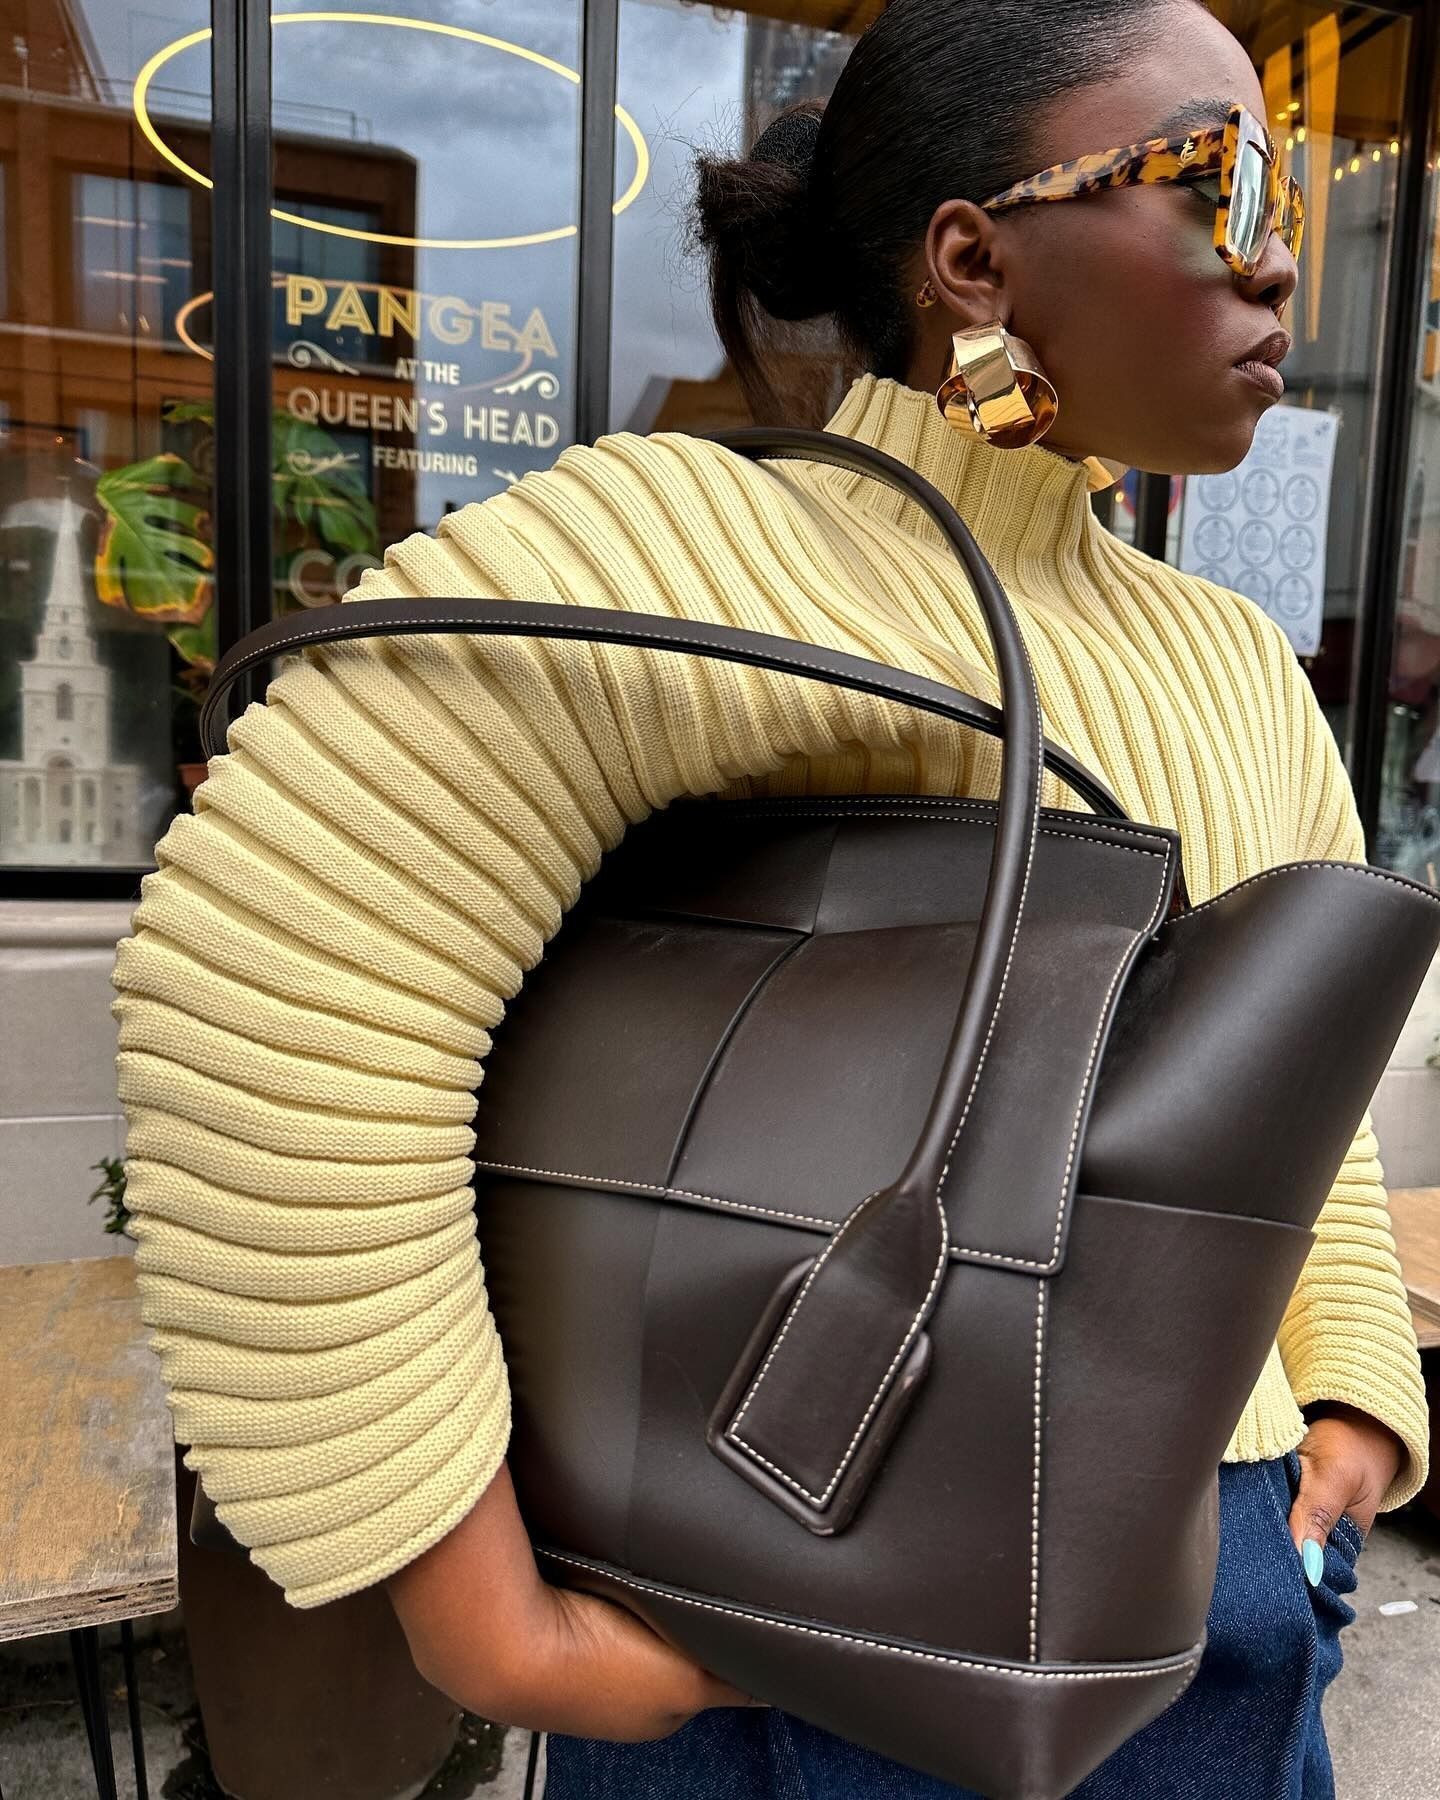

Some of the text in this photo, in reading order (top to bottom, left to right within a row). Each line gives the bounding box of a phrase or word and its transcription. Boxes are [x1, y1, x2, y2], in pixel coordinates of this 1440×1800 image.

[287, 275, 558, 358] PANGEA
[395, 357, 460, 385] AT THE
[288, 387, 559, 448] QUEEN'S HEAD
[373, 446, 478, 476] FEATURING
